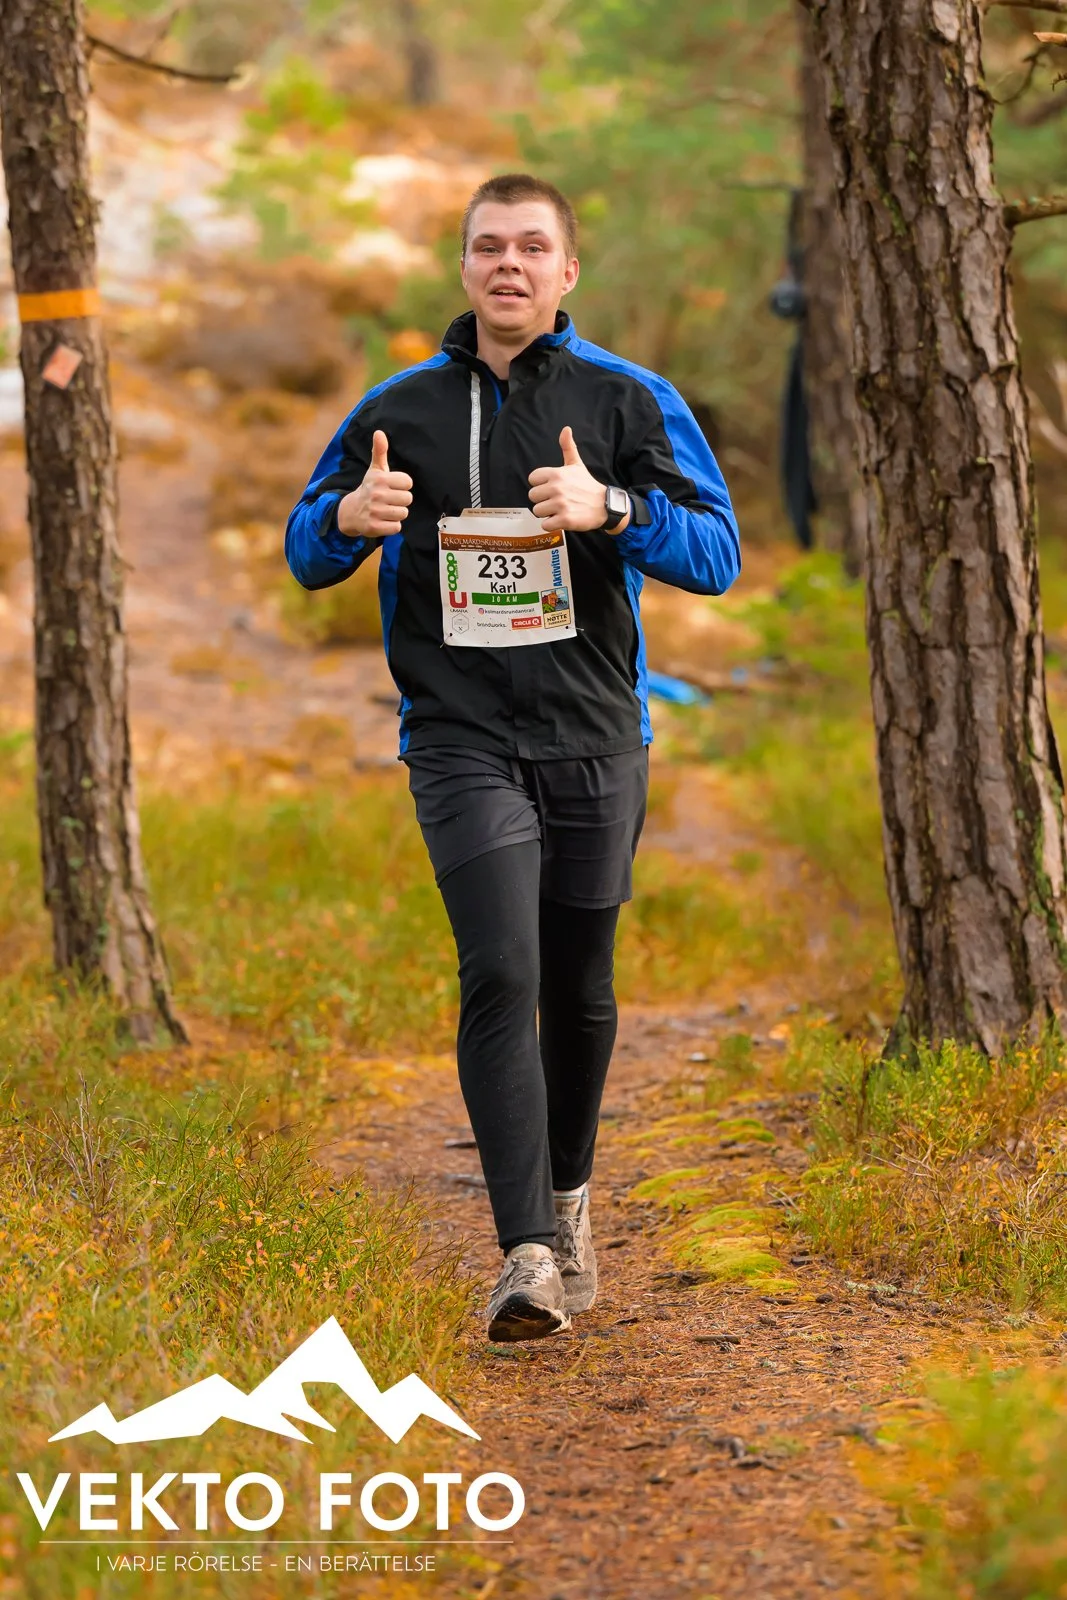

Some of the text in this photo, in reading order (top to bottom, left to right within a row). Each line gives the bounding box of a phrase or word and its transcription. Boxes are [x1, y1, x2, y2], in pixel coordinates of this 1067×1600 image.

[446, 552, 458, 591] coop
[477, 554, 528, 579] 233
[551, 549, 562, 586] Aktivitus
[490, 582, 517, 593] Karl
[491, 595, 518, 603] 10 KM
